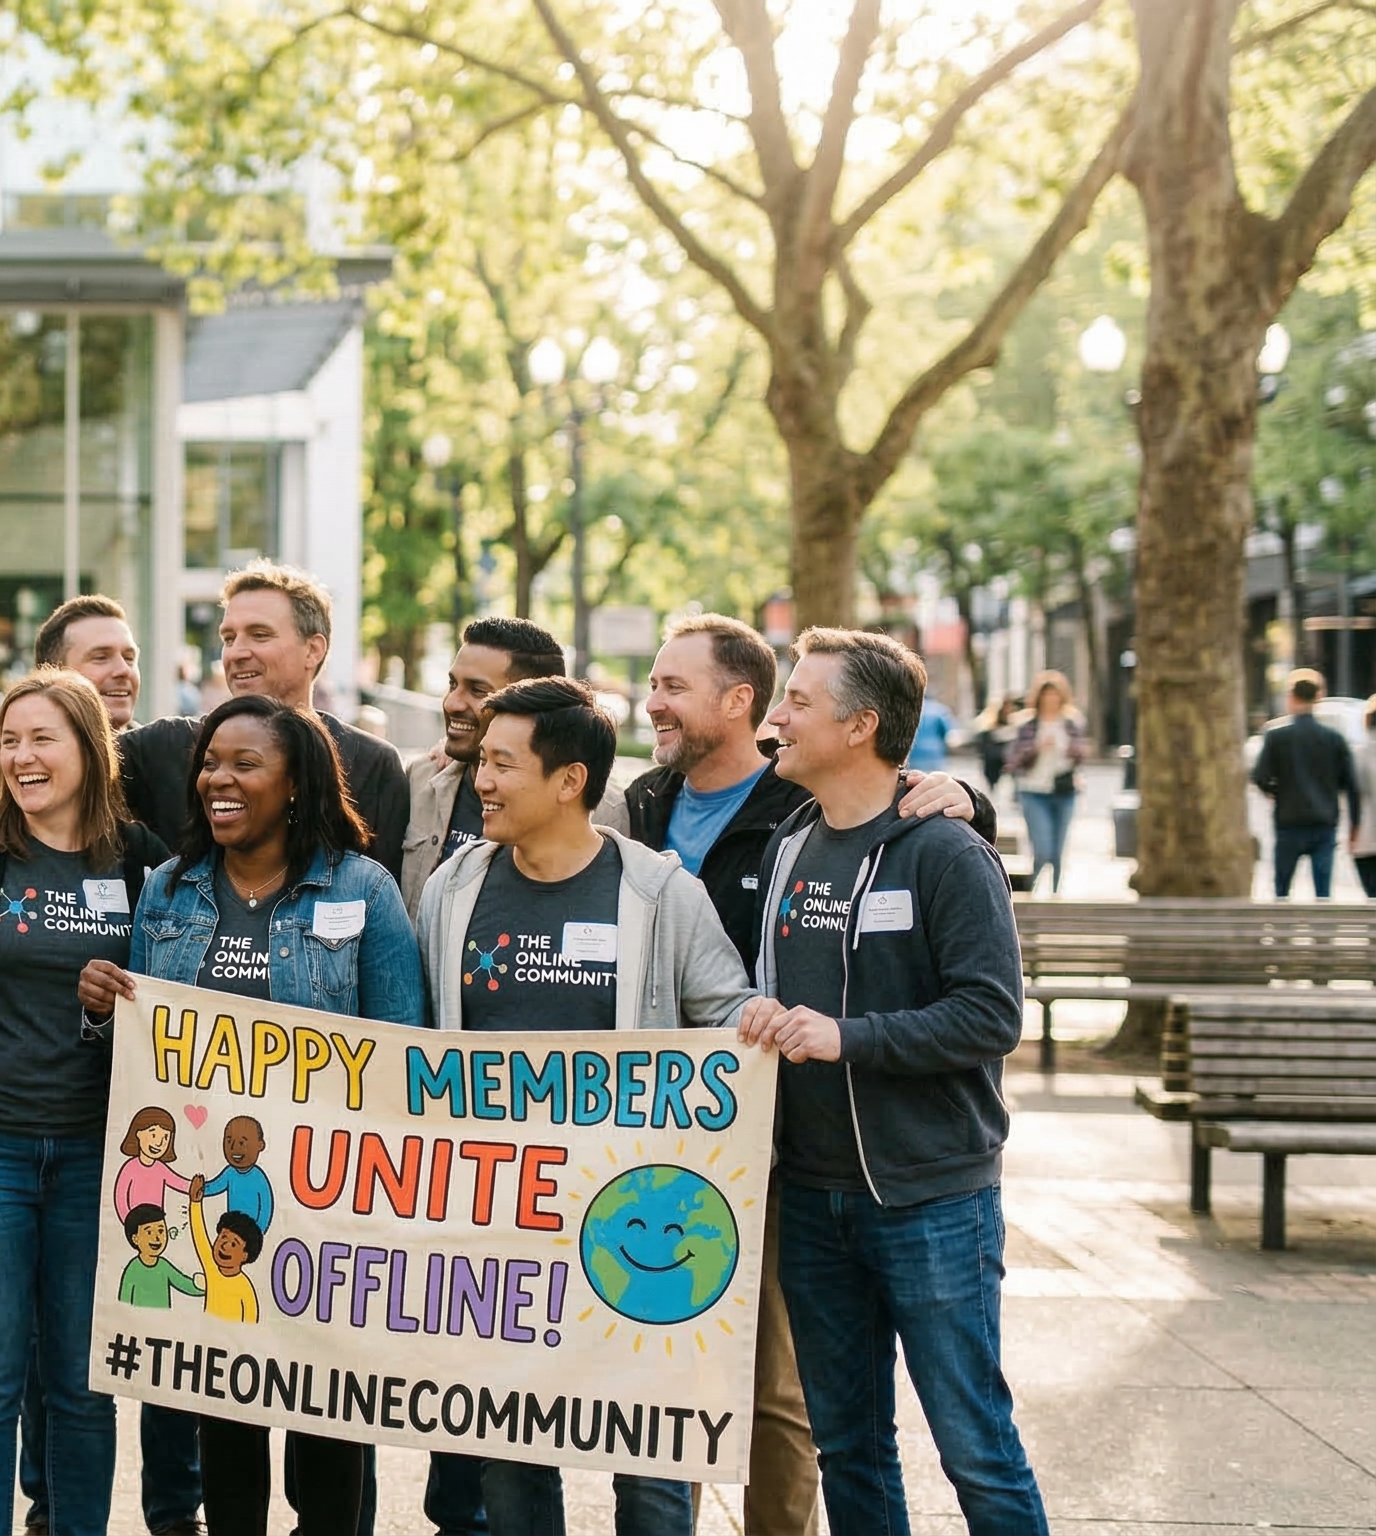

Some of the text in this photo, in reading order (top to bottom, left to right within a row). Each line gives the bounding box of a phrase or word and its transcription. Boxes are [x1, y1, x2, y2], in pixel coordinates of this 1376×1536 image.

[807, 881, 832, 896] THE
[44, 889, 77, 905] THE
[44, 904, 107, 921] ONLINE
[219, 936, 253, 950] THE
[517, 934, 551, 949] THE
[211, 965, 271, 980] COMM
[151, 1004, 740, 1133] HAPPY MEMBERS
[289, 1125, 569, 1232] UNITE
[270, 1237, 569, 1348] OFFLINE!
[105, 1332, 734, 1465] #THEONLINECOMMUNITY
